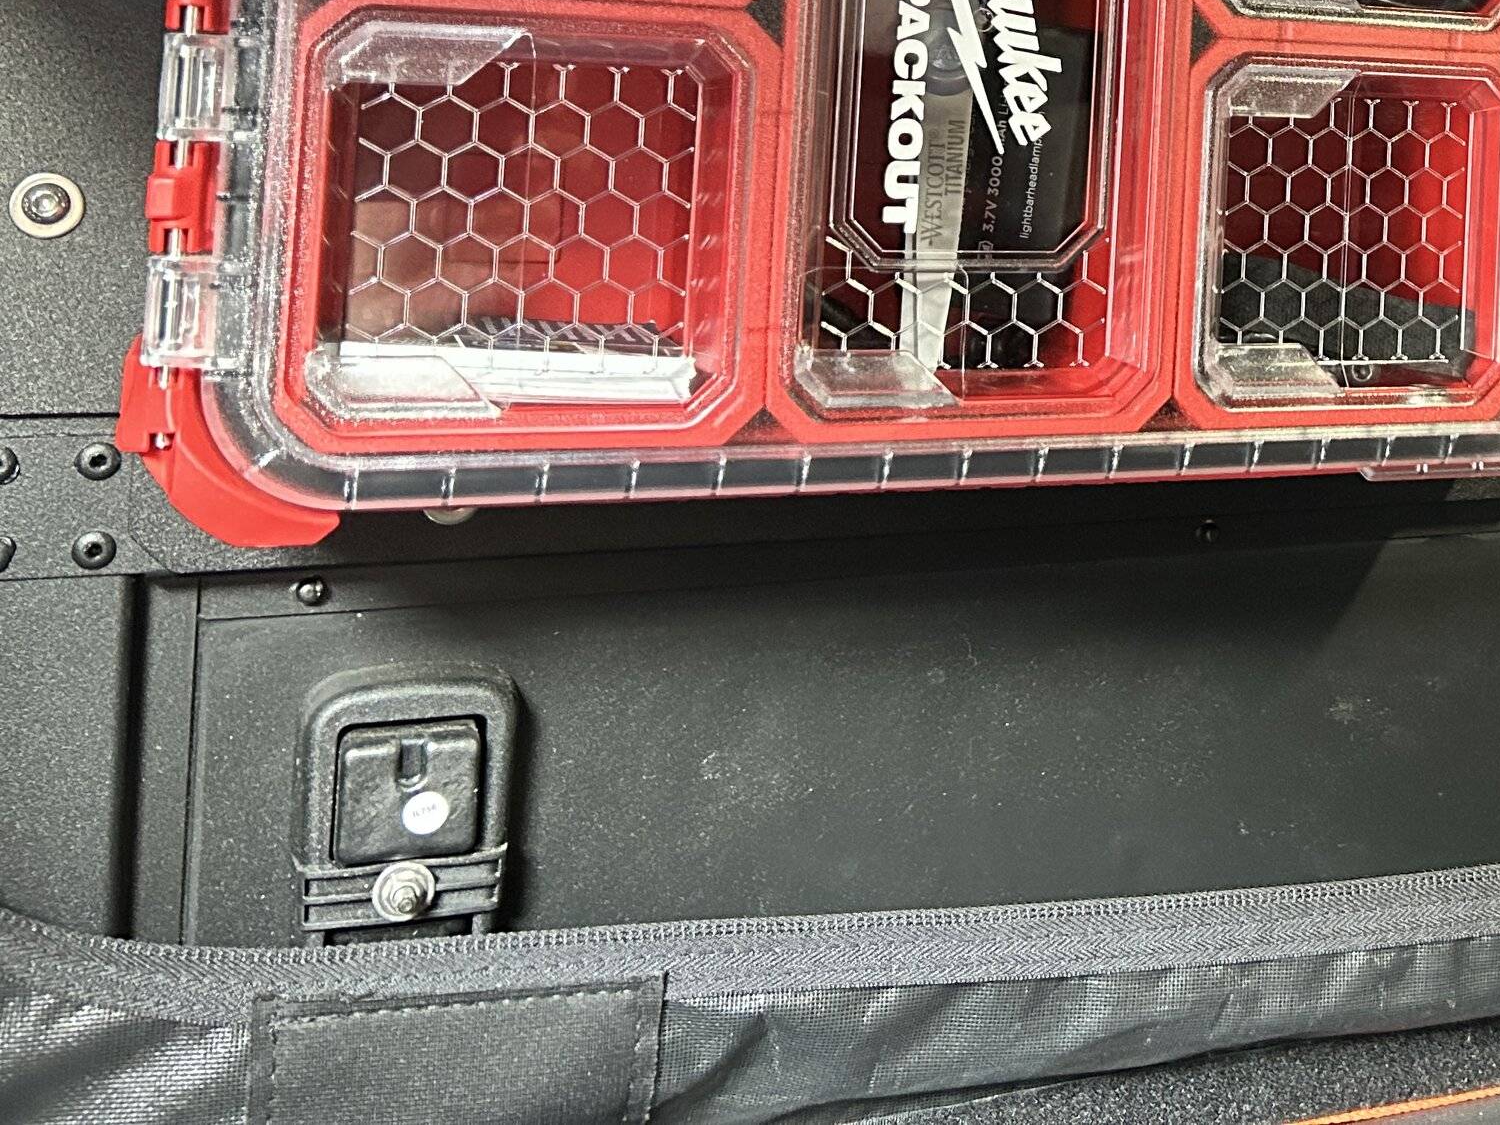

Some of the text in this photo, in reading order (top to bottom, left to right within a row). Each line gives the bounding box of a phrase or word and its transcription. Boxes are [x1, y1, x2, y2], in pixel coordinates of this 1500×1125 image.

[944, 119, 966, 196] TITANIUM
[986, 156, 1004, 197] 3000
[981, 199, 999, 233] 3.7V
